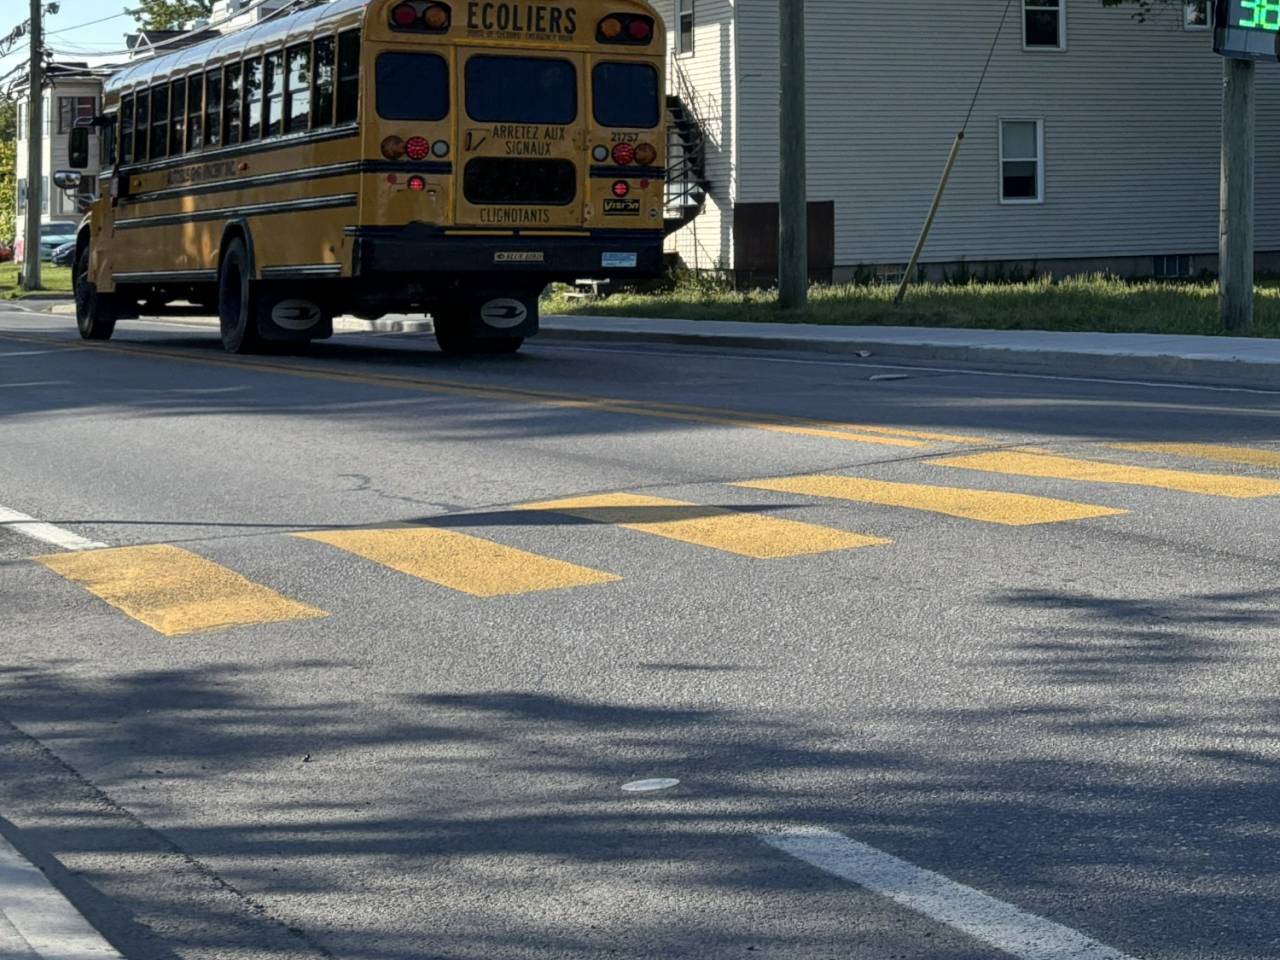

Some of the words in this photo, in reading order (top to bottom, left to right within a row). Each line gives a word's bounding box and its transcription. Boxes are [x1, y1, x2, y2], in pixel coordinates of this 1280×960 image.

[543, 126, 565, 141] AUX
[505, 141, 551, 156] SIGNAUX
[480, 207, 550, 224] CLIGNOTANTS
